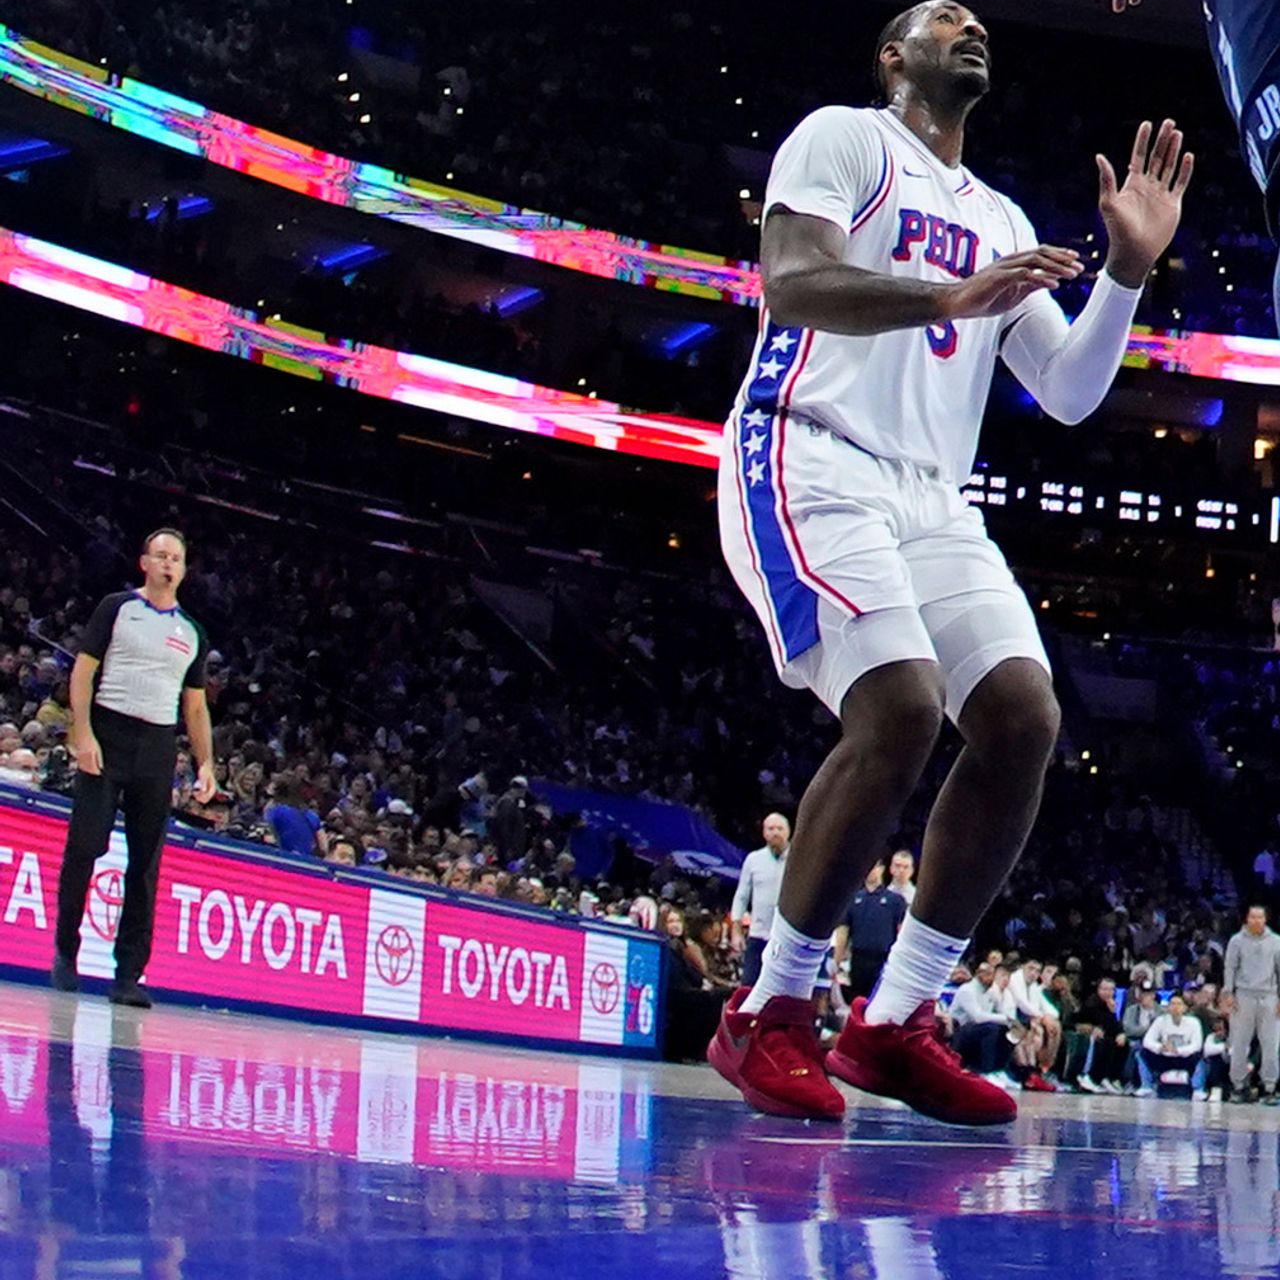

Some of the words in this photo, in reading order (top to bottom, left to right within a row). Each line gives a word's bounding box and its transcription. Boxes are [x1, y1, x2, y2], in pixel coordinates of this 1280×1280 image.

[891, 207, 1002, 280] PHIL
[1042, 481, 1064, 496] SAC
[171, 882, 348, 980] TOYOTA
[437, 933, 571, 1011] TOYOTA
[626, 983, 655, 1035] 76
